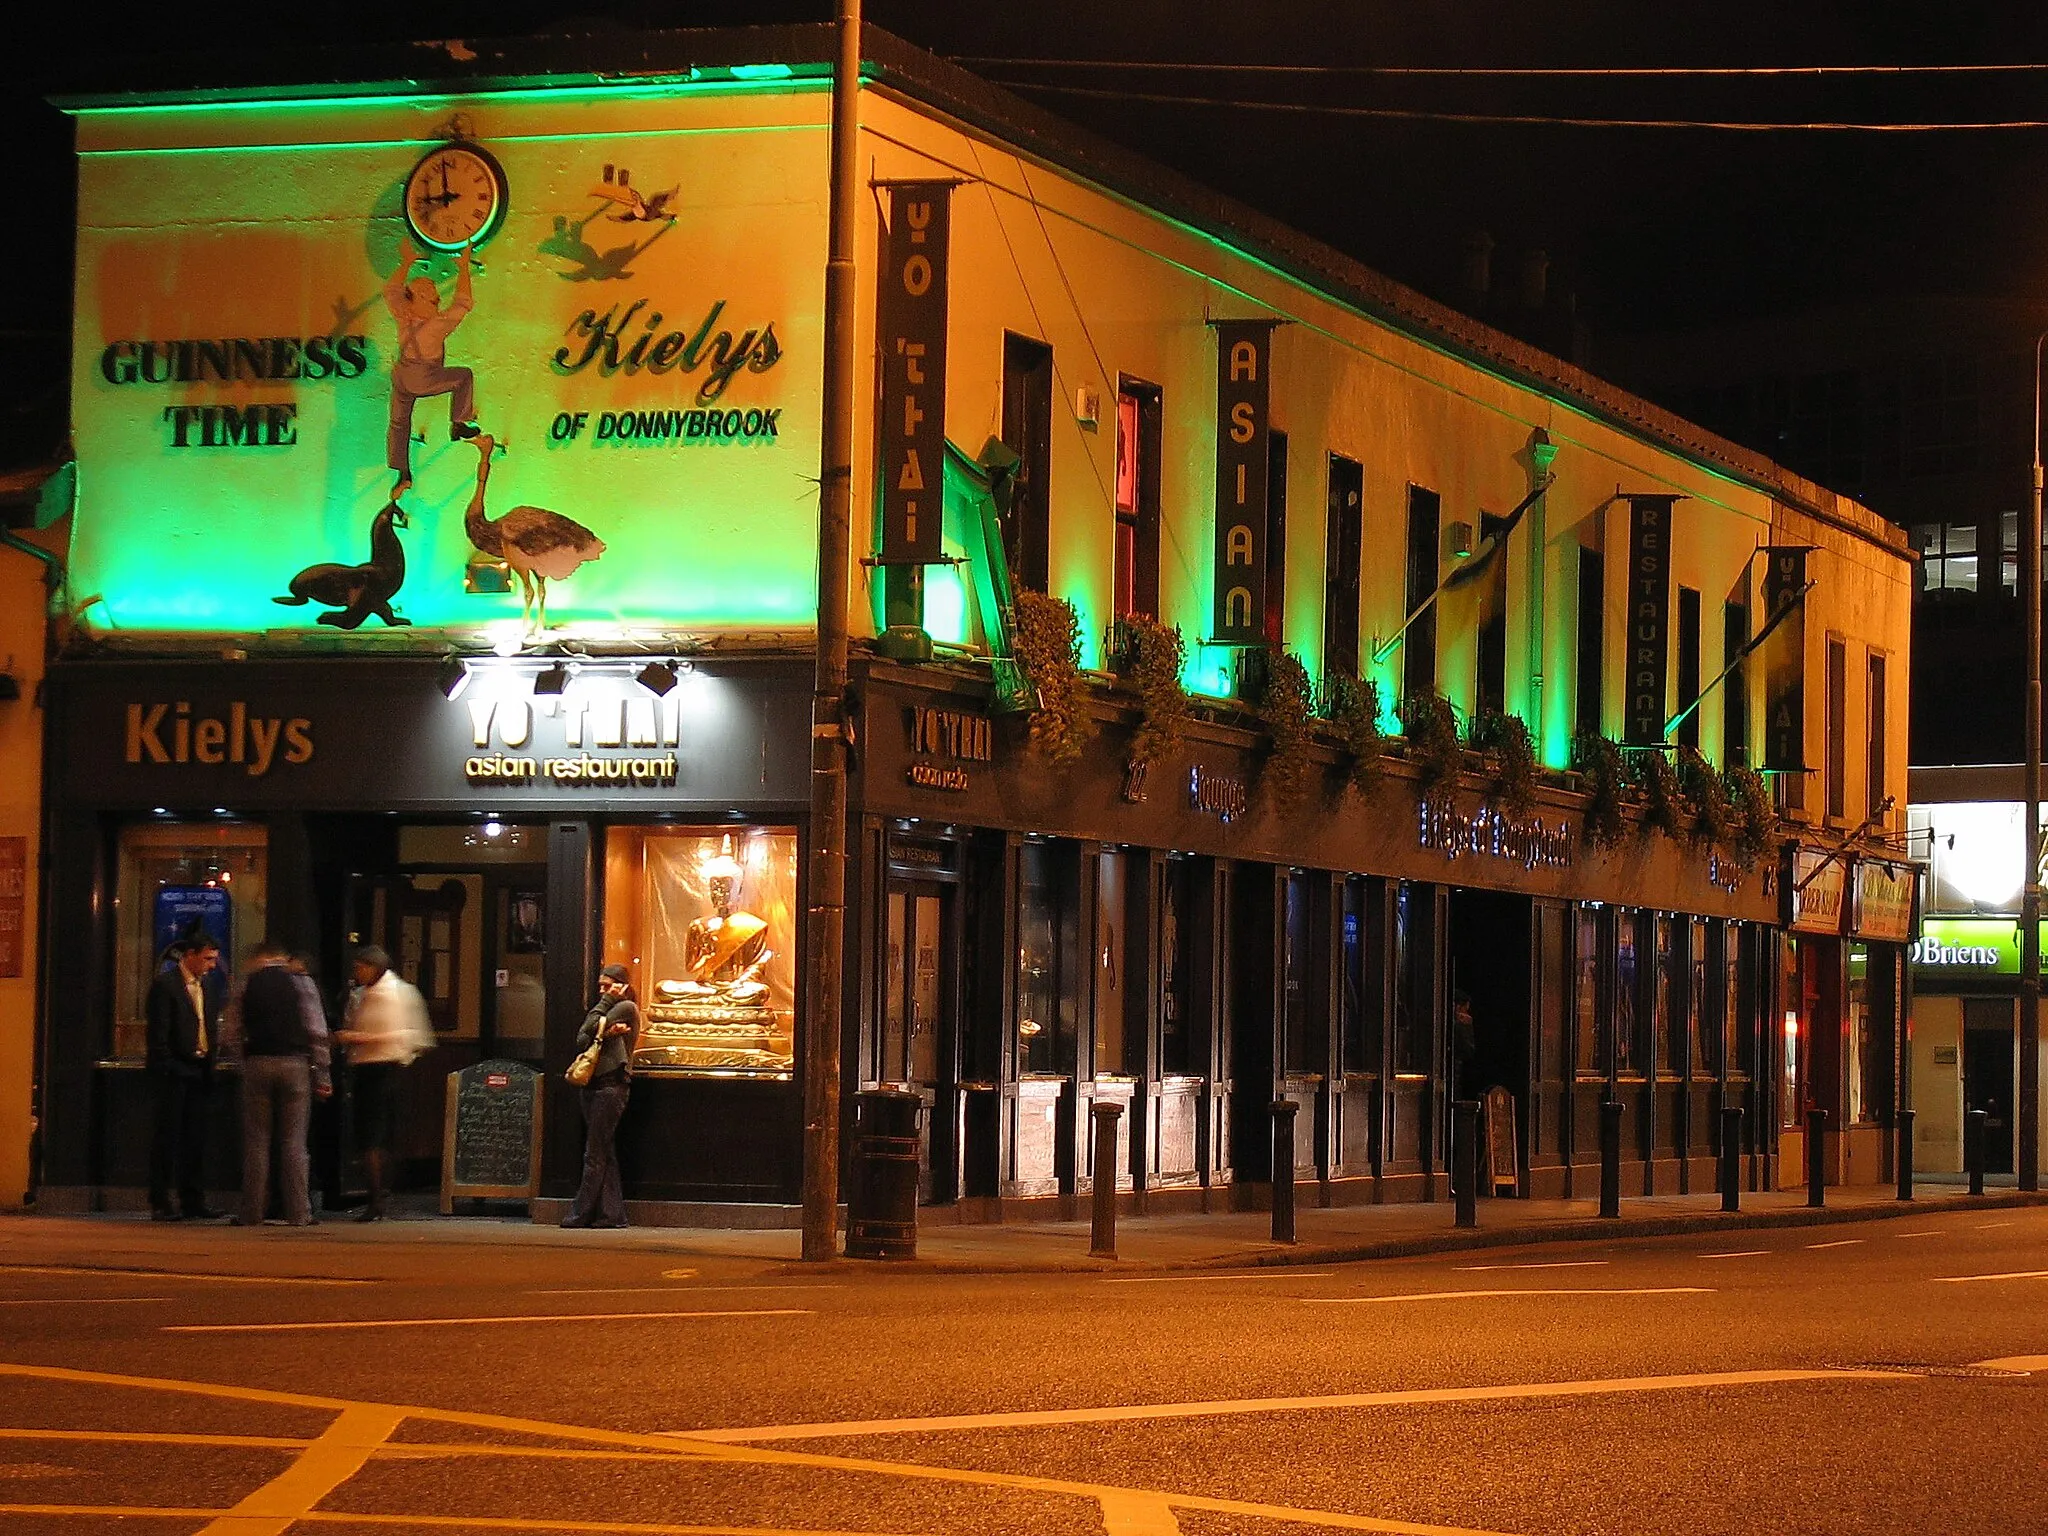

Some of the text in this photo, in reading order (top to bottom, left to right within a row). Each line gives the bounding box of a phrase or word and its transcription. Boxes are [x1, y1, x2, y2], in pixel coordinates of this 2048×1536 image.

[101, 335, 367, 384] GUINNESS
[552, 298, 783, 402] Kielys
[162, 403, 297, 447] TIME
[551, 408, 783, 441] OF DONNYBROOK
[1225, 340, 1257, 628] ASIAN
[1636, 509, 1658, 735] RESTAURANT
[125, 701, 314, 776] Kielys
[465, 752, 677, 779] asian restaurant
